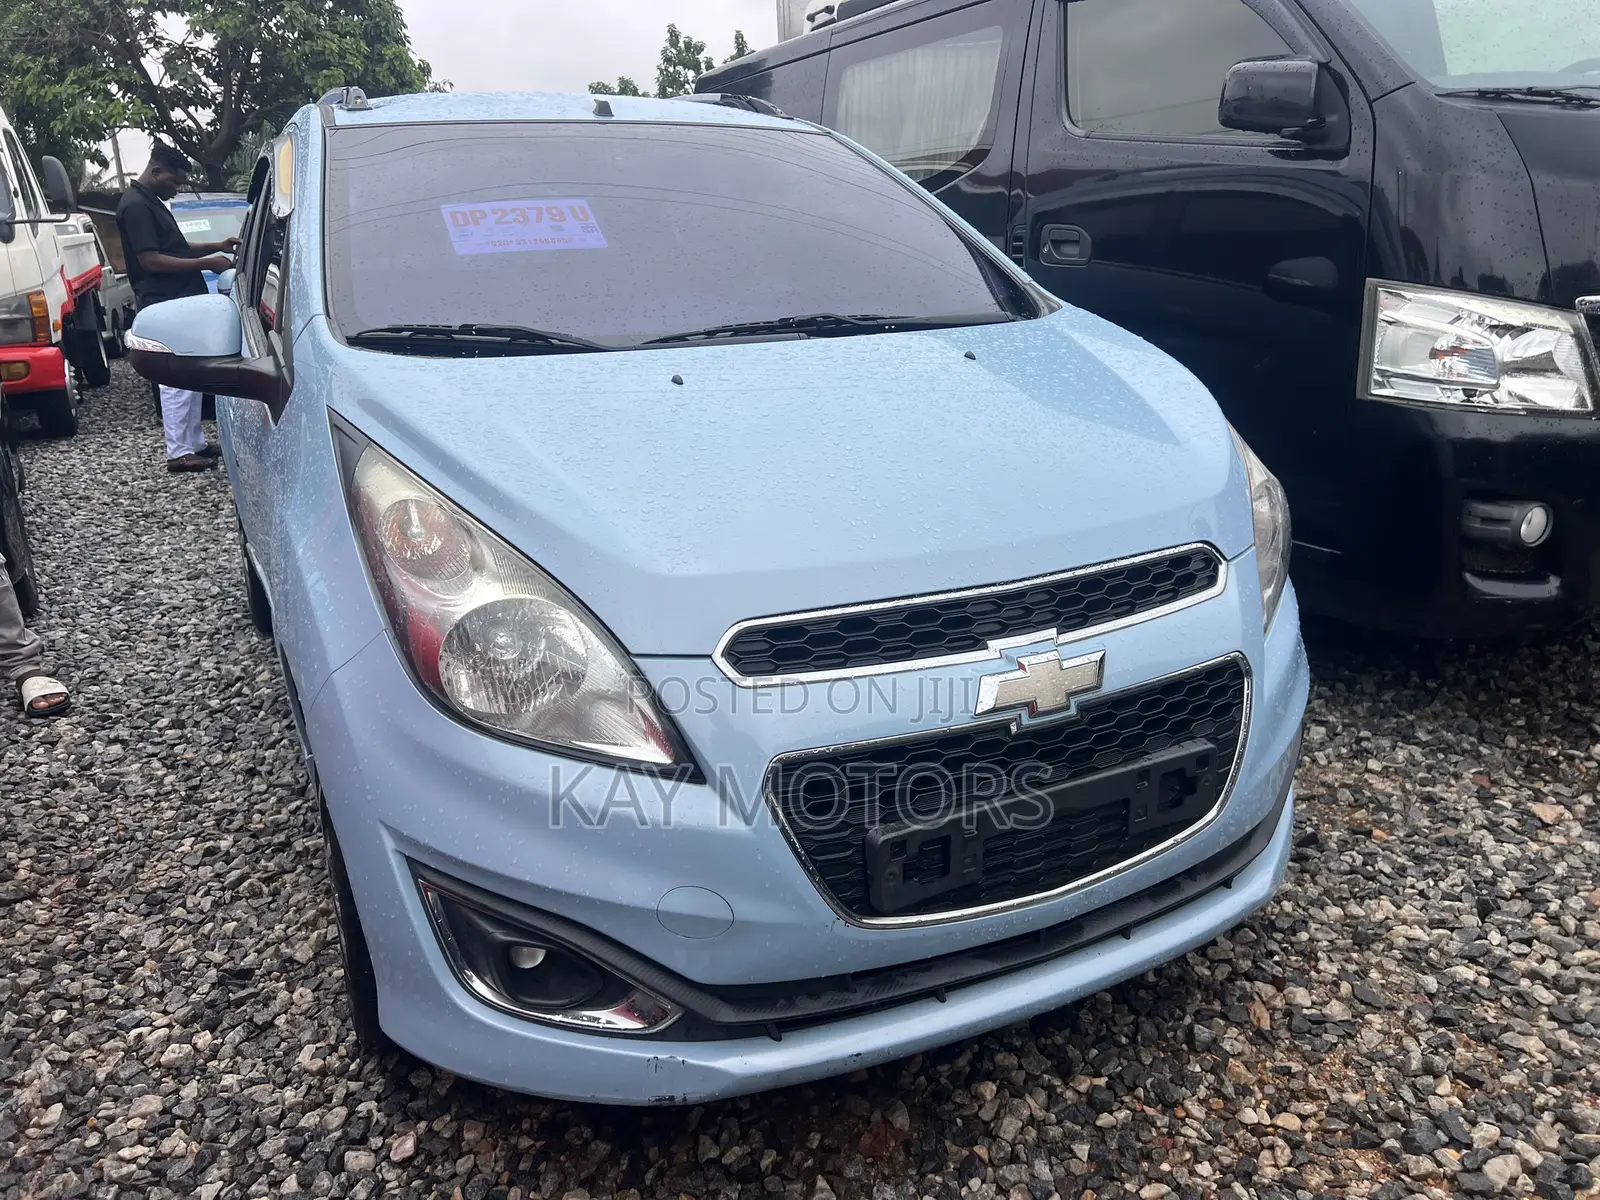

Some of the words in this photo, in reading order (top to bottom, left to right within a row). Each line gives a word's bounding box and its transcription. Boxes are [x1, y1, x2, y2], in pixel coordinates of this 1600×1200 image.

[450, 210, 488, 228] DP
[491, 205, 566, 226] 2379
[570, 205, 590, 222] U
